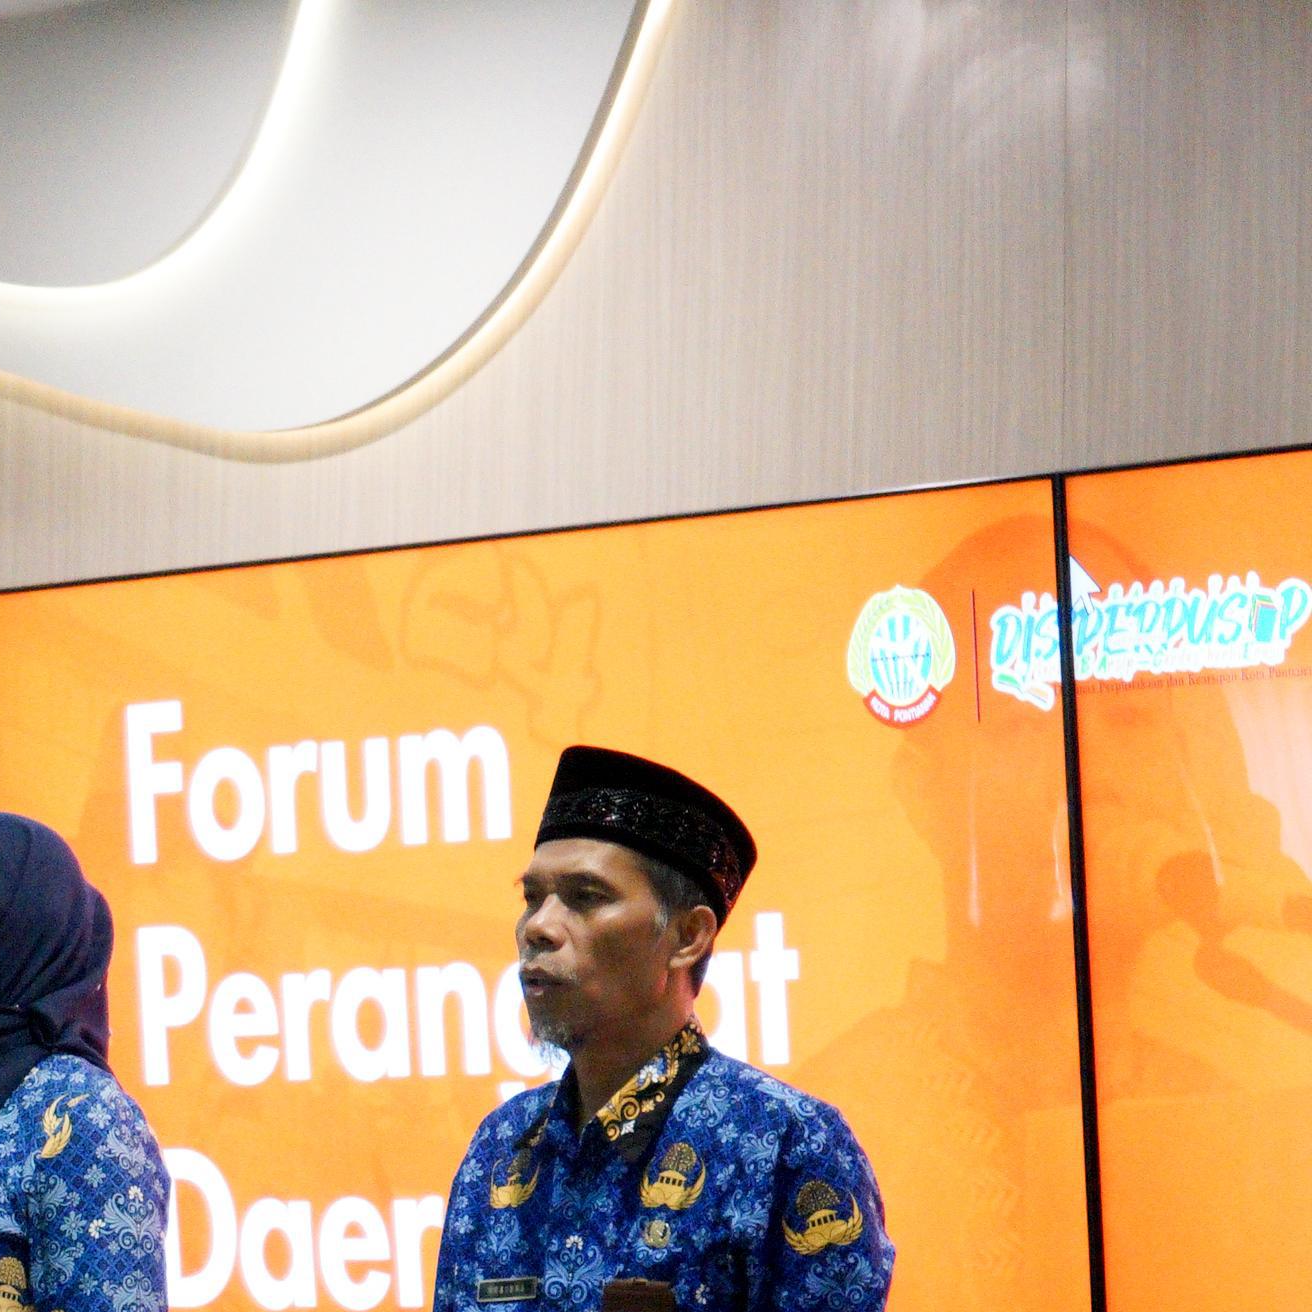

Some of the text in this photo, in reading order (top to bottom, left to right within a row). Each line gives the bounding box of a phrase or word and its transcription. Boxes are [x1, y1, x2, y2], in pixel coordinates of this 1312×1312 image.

[125, 700, 511, 864] Forum
[136, 912, 800, 1100] Peranat
[164, 1147, 444, 1311] Daer
